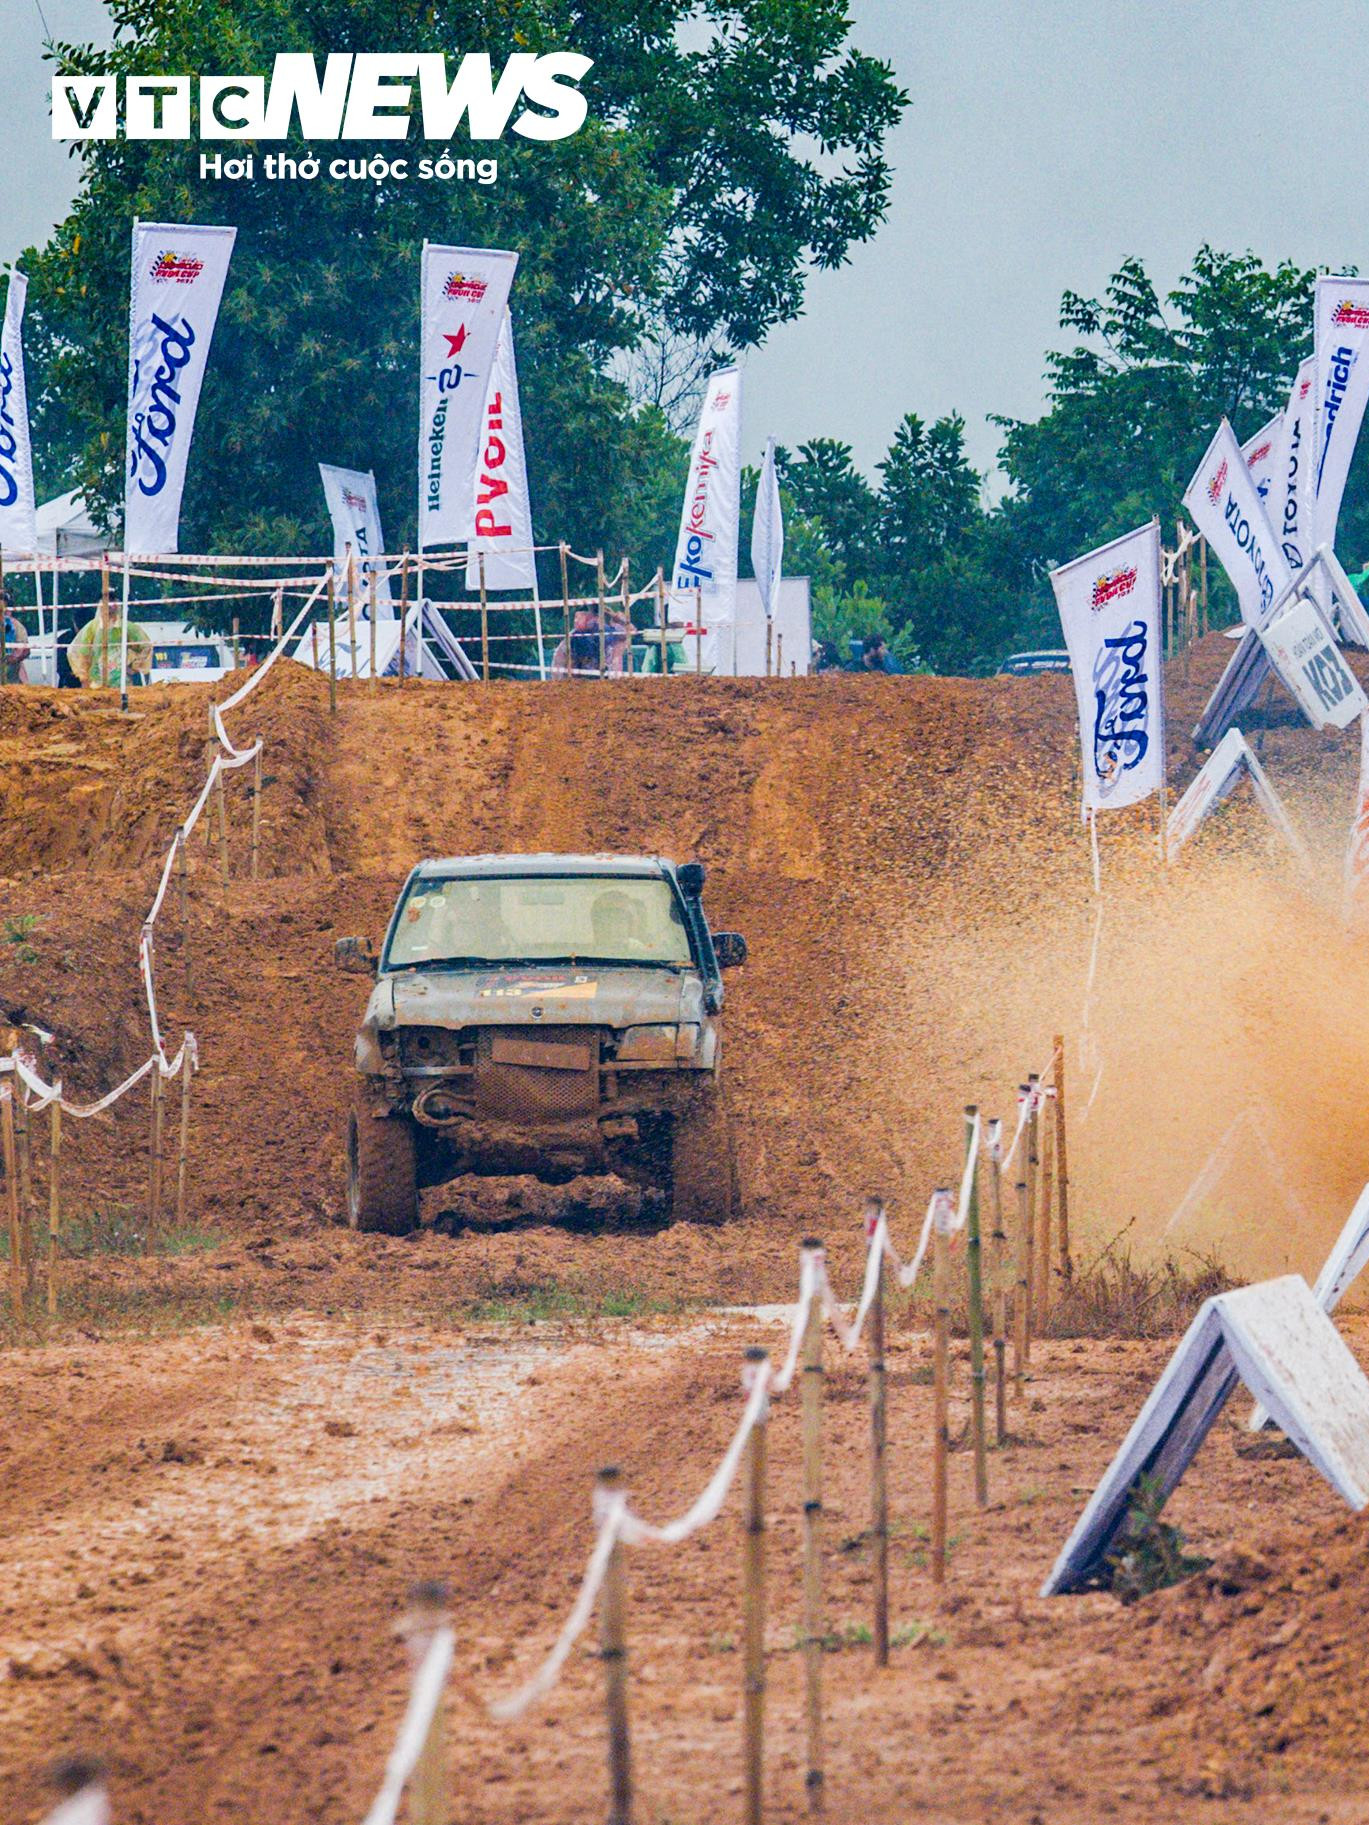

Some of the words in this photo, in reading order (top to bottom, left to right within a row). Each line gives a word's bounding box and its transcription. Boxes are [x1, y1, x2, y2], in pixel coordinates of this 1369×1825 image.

[131, 313, 195, 496] Ford
[428, 397, 449, 513] Heineken
[475, 392, 512, 536] PVOIL
[1094, 620, 1149, 779] Ford
